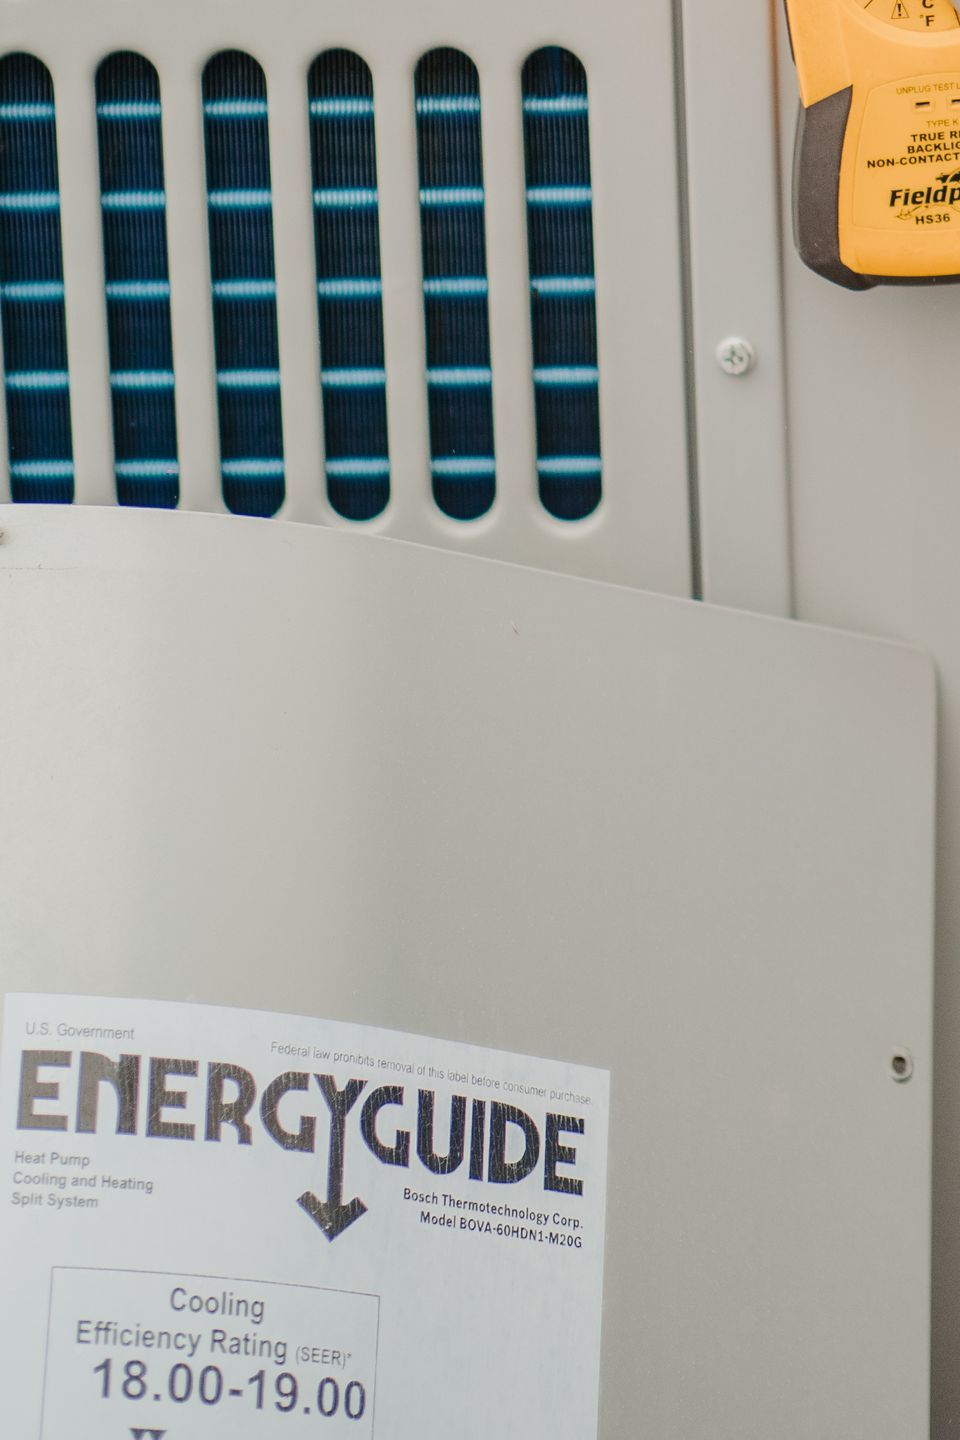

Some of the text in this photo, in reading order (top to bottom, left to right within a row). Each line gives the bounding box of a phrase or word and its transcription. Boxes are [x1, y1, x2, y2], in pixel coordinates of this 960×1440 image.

[896, 85, 930, 95] UNPLUG
[933, 83, 954, 91] TEST
[926, 119, 950, 127] TYPE
[911, 131, 944, 142] TRUE
[867, 153, 959, 168] NON-CONTACT
[915, 214, 950, 225] HS36
[26, 1022, 134, 1040] U.S. Government
[271, 1042, 310, 1057] Federal
[313, 1048, 330, 1060] law
[377, 1059, 415, 1073] removal
[417, 1064, 426, 1075] of
[428, 1066, 444, 1079] this
[447, 1069, 469, 1083] label
[471, 1074, 501, 1088] before
[503, 1081, 547, 1096] consumer
[16, 1048, 585, 1200] ENERGYGUIDE
[15, 1151, 90, 1168] Heat Pump
[12, 1172, 153, 1193] Cooling and Heating
[12, 1192, 98, 1210] Split System
[403, 1188, 583, 1230] Bosch Thermotechnology Corp.
[420, 1211, 582, 1249] Model BOVA-60HDN1-M20G
[170, 1287, 265, 1324] Cooling
[76, 1320, 200, 1356] Efficiency
[210, 1329, 287, 1366] Rating
[93, 1358, 366, 1421] 18.00-19.00
